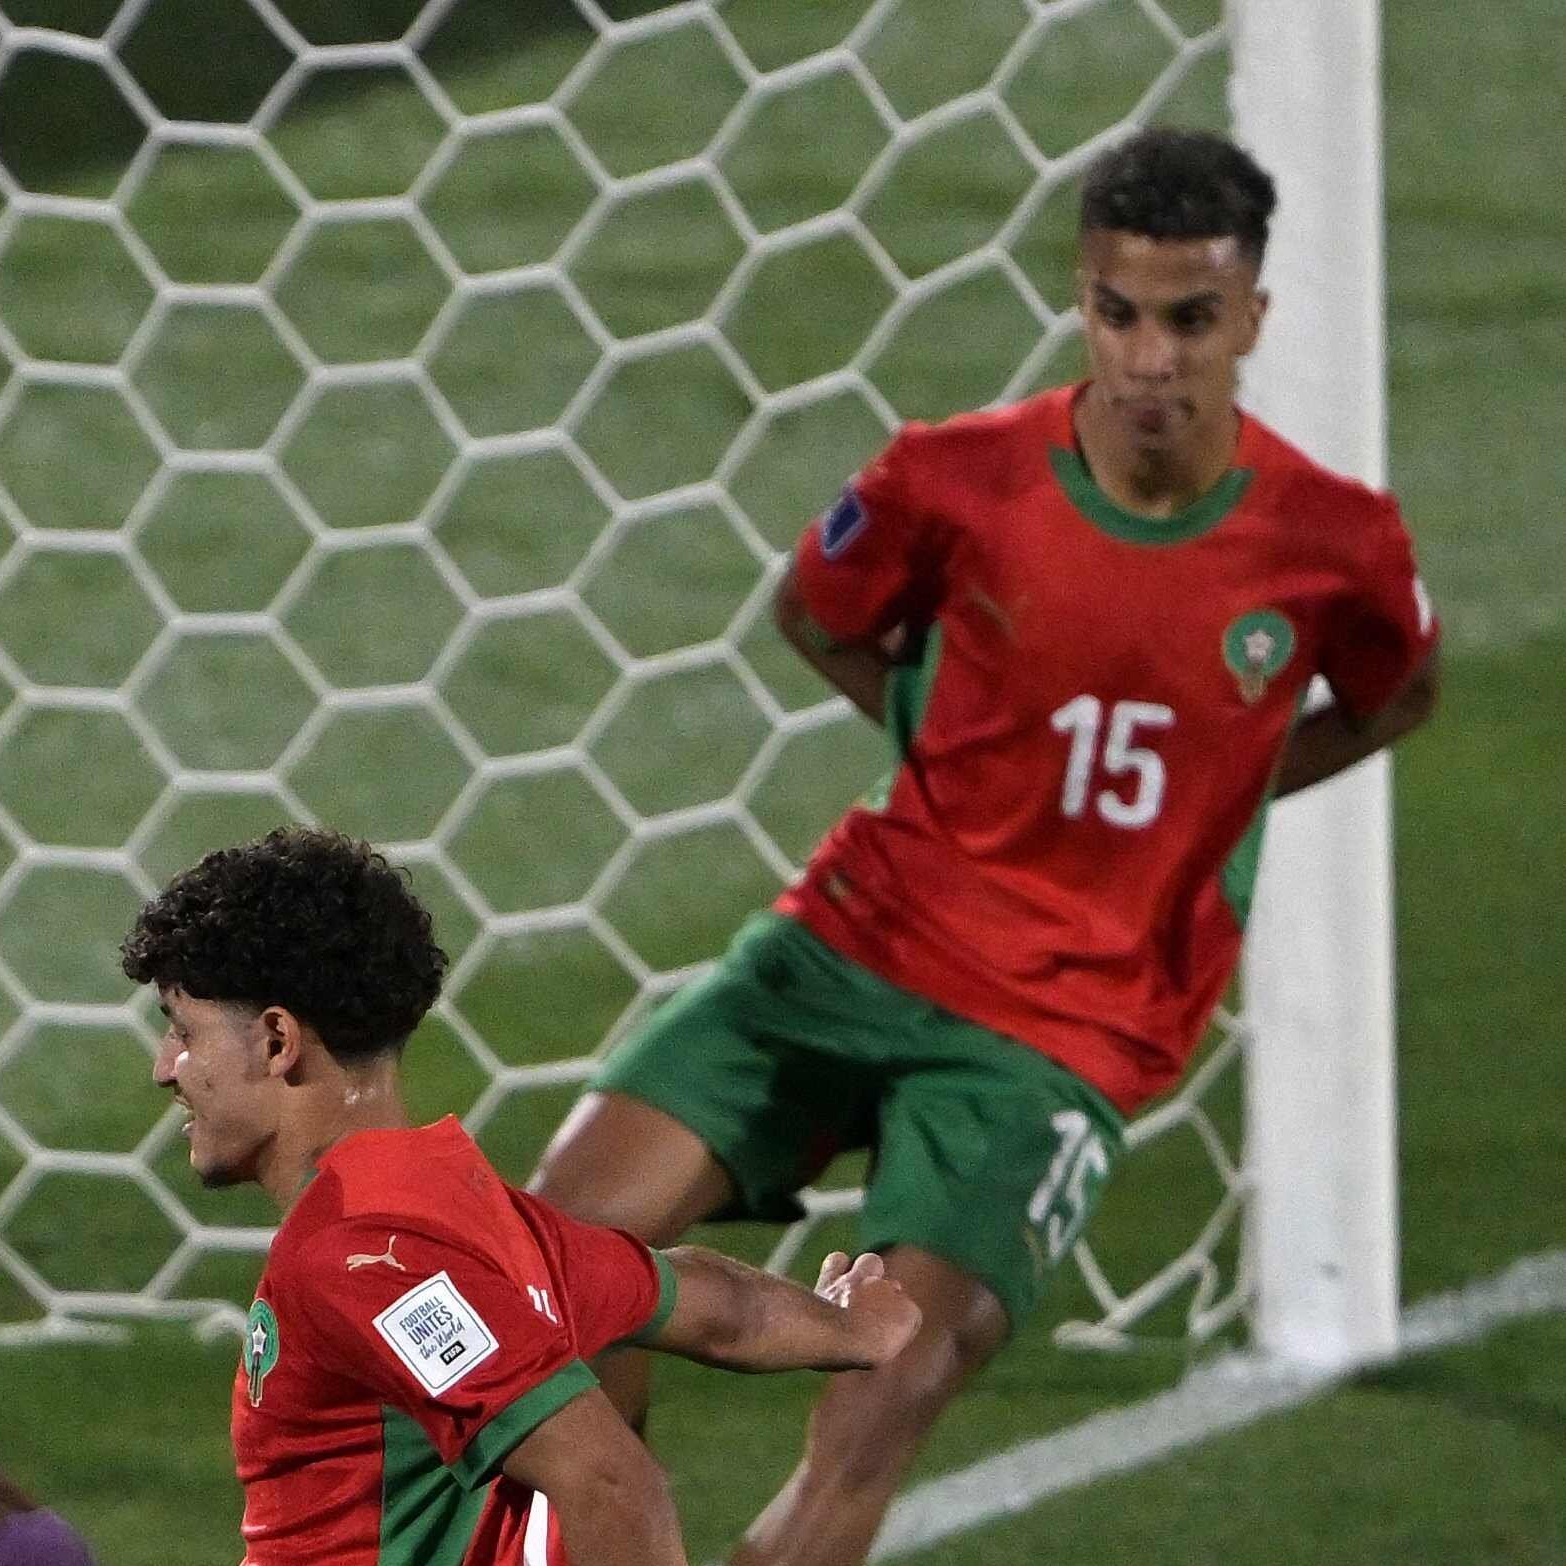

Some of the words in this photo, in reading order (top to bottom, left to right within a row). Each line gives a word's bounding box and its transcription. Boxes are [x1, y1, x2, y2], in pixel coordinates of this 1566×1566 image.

[1050, 693, 1176, 829] 15
[1027, 1109, 1108, 1260] 15
[399, 1295, 444, 1332] FOOTBALL
[407, 1304, 453, 1346] UNITES
